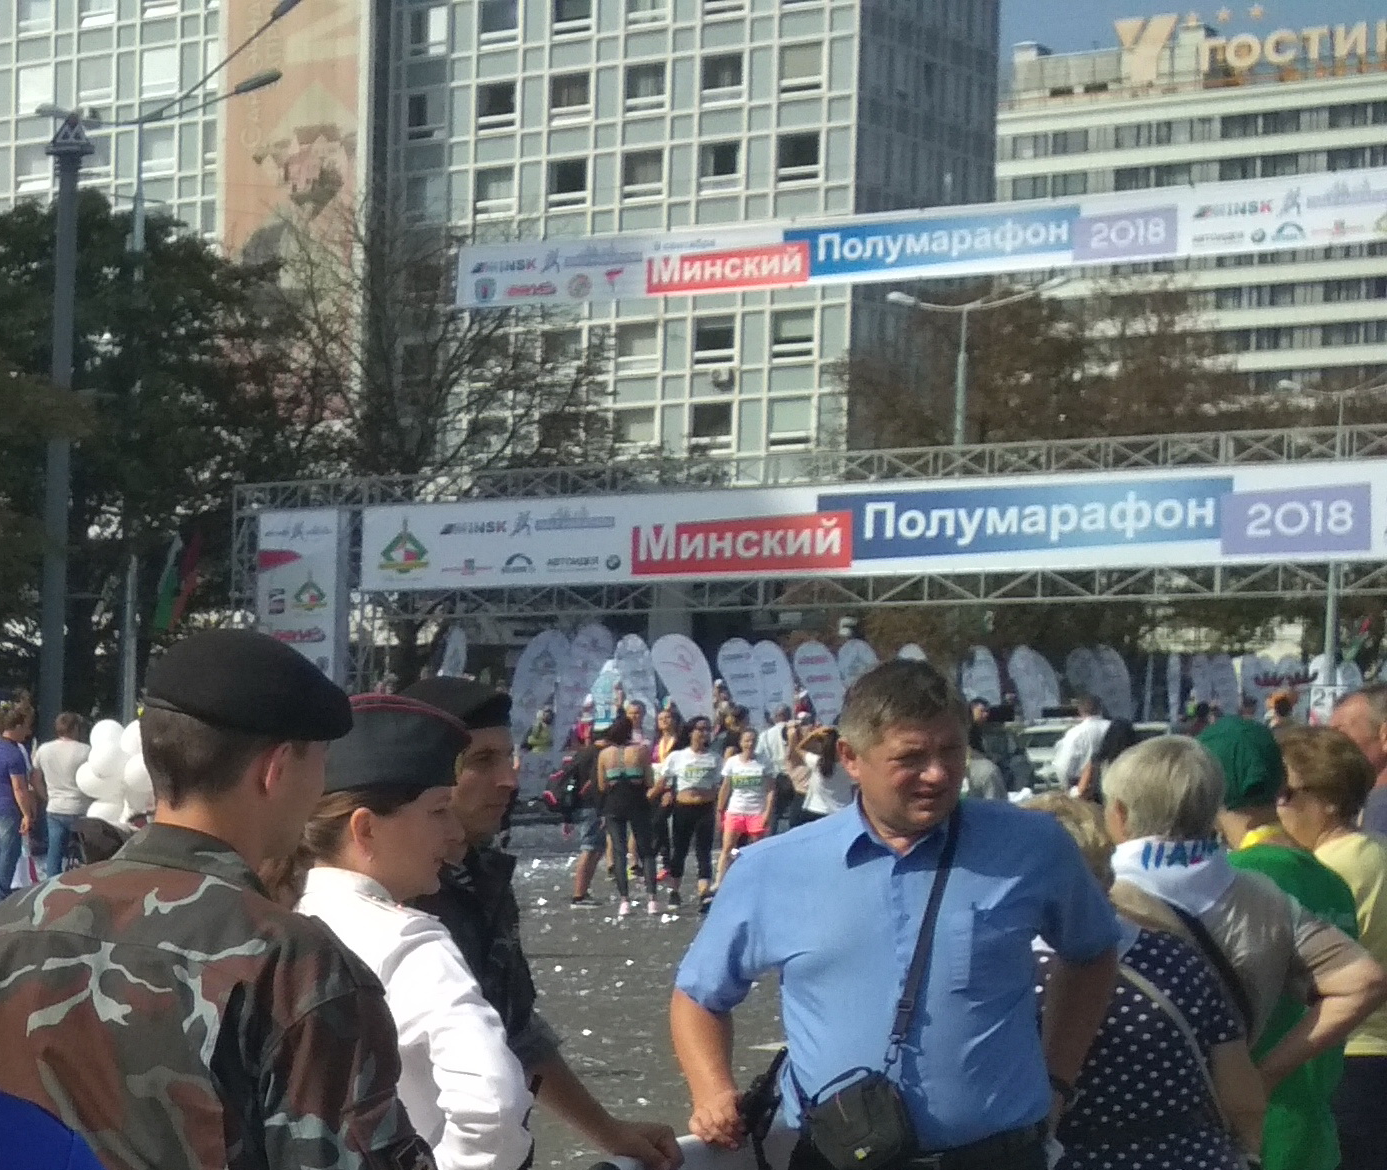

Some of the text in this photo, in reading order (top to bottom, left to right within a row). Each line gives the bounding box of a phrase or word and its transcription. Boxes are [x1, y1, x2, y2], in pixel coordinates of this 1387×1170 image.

[652, 249, 802, 284] Минский
[817, 214, 1069, 264] Полумарафон
[1090, 218, 1165, 249] 2018
[638, 493, 1354, 561] Минский Полумарафон 2018
